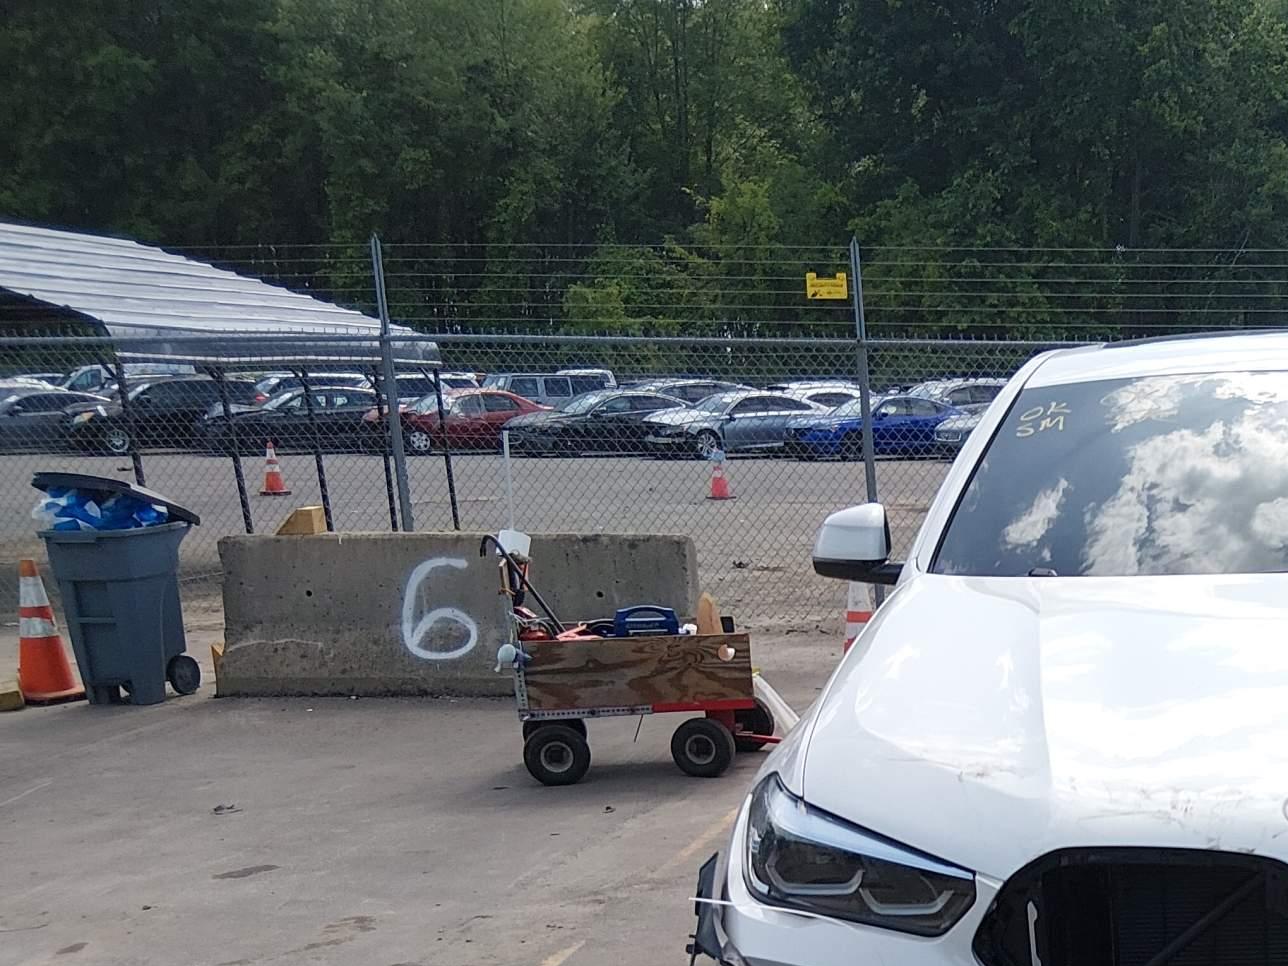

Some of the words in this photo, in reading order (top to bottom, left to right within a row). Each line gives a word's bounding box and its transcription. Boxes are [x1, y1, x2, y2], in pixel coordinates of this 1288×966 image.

[1020, 401, 1072, 421] OK
[1016, 415, 1065, 437] SM
[402, 557, 478, 659] 6
